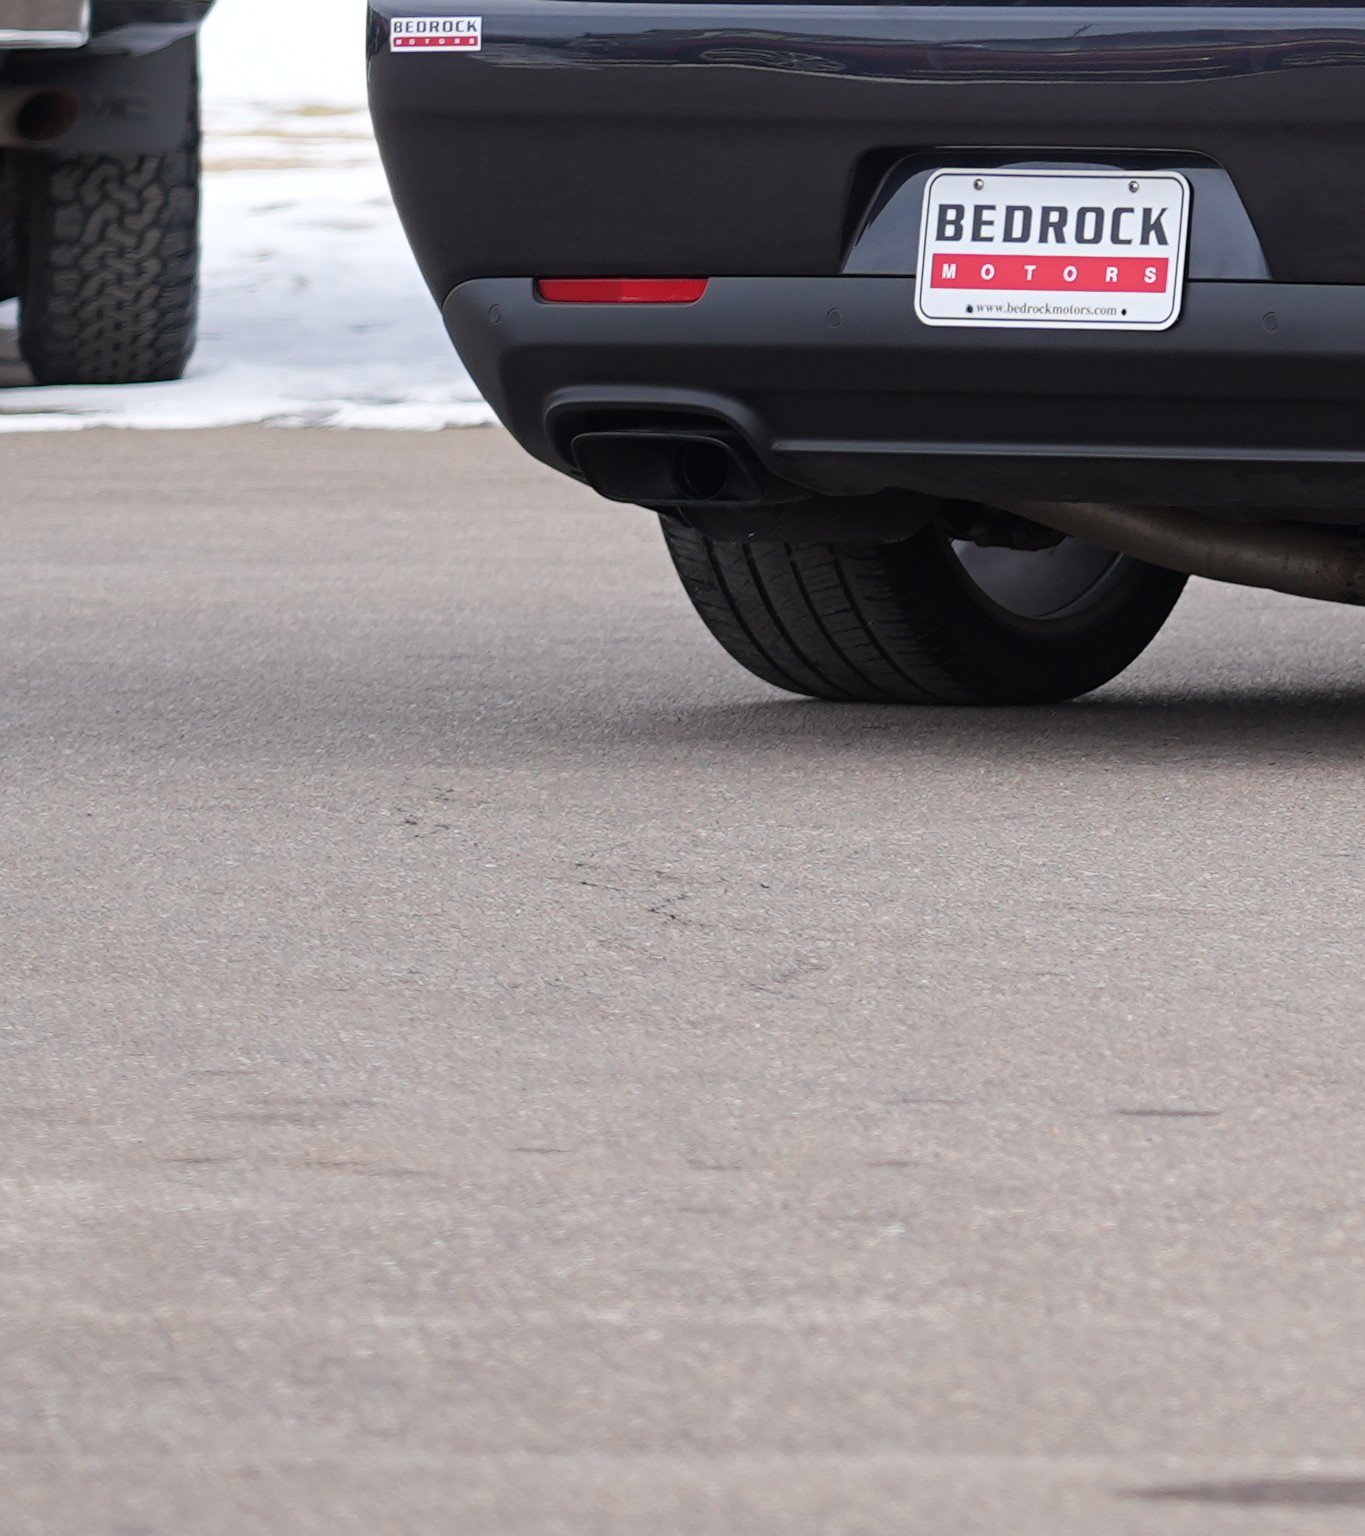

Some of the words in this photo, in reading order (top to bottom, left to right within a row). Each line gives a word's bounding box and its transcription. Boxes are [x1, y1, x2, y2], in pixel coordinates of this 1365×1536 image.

[393, 20, 478, 34] BEDROCK
[394, 37, 475, 46] MOTORS
[934, 203, 1170, 246] BEDROCK
[941, 263, 1158, 284] MOTORS
[975, 302, 1118, 317] www.bedrockmotors.com
